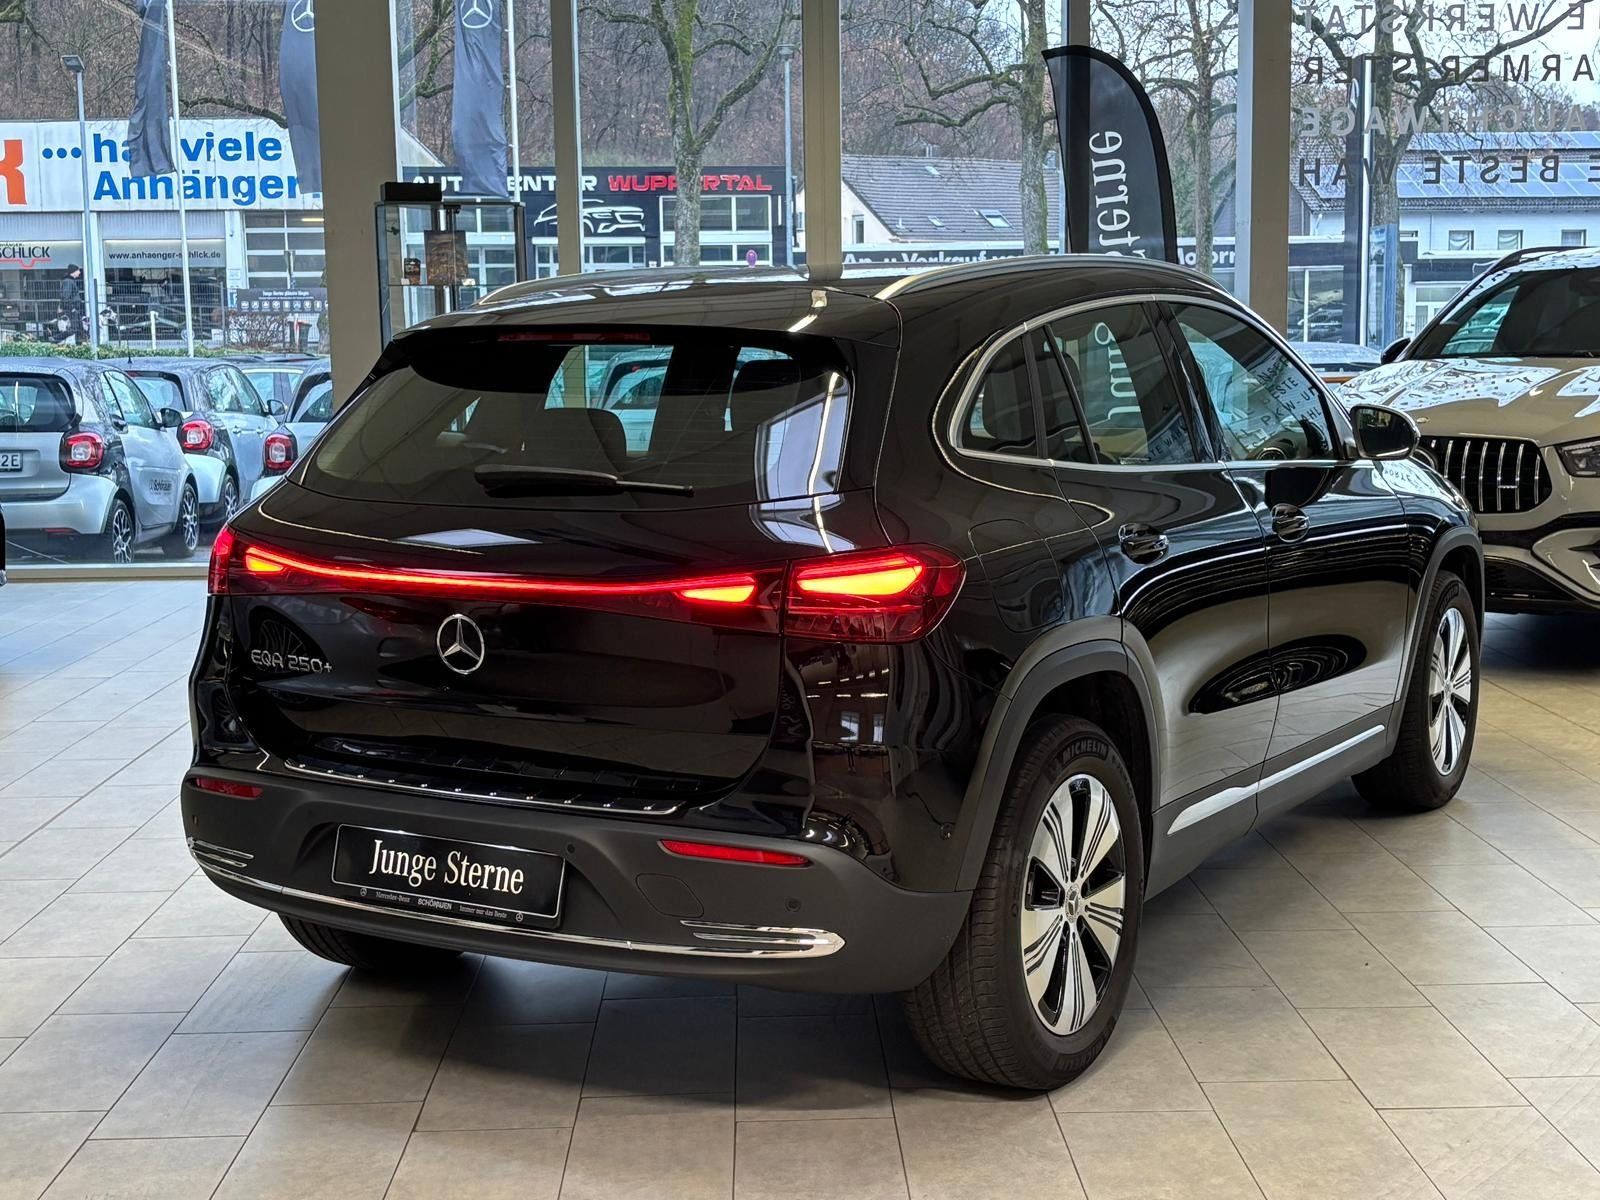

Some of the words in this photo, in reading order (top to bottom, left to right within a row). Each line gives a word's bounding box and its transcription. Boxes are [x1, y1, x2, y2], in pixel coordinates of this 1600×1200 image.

[180, 132, 282, 161] viele
[608, 175, 773, 191] WUPPRTAL
[0, 246, 50, 258] CHLICK
[251, 649, 284, 668] EQA
[287, 654, 332, 673] 250+
[1063, 738, 1108, 763] MICHELIN
[369, 839, 437, 887] Junge
[444, 850, 524, 894] Sterne
